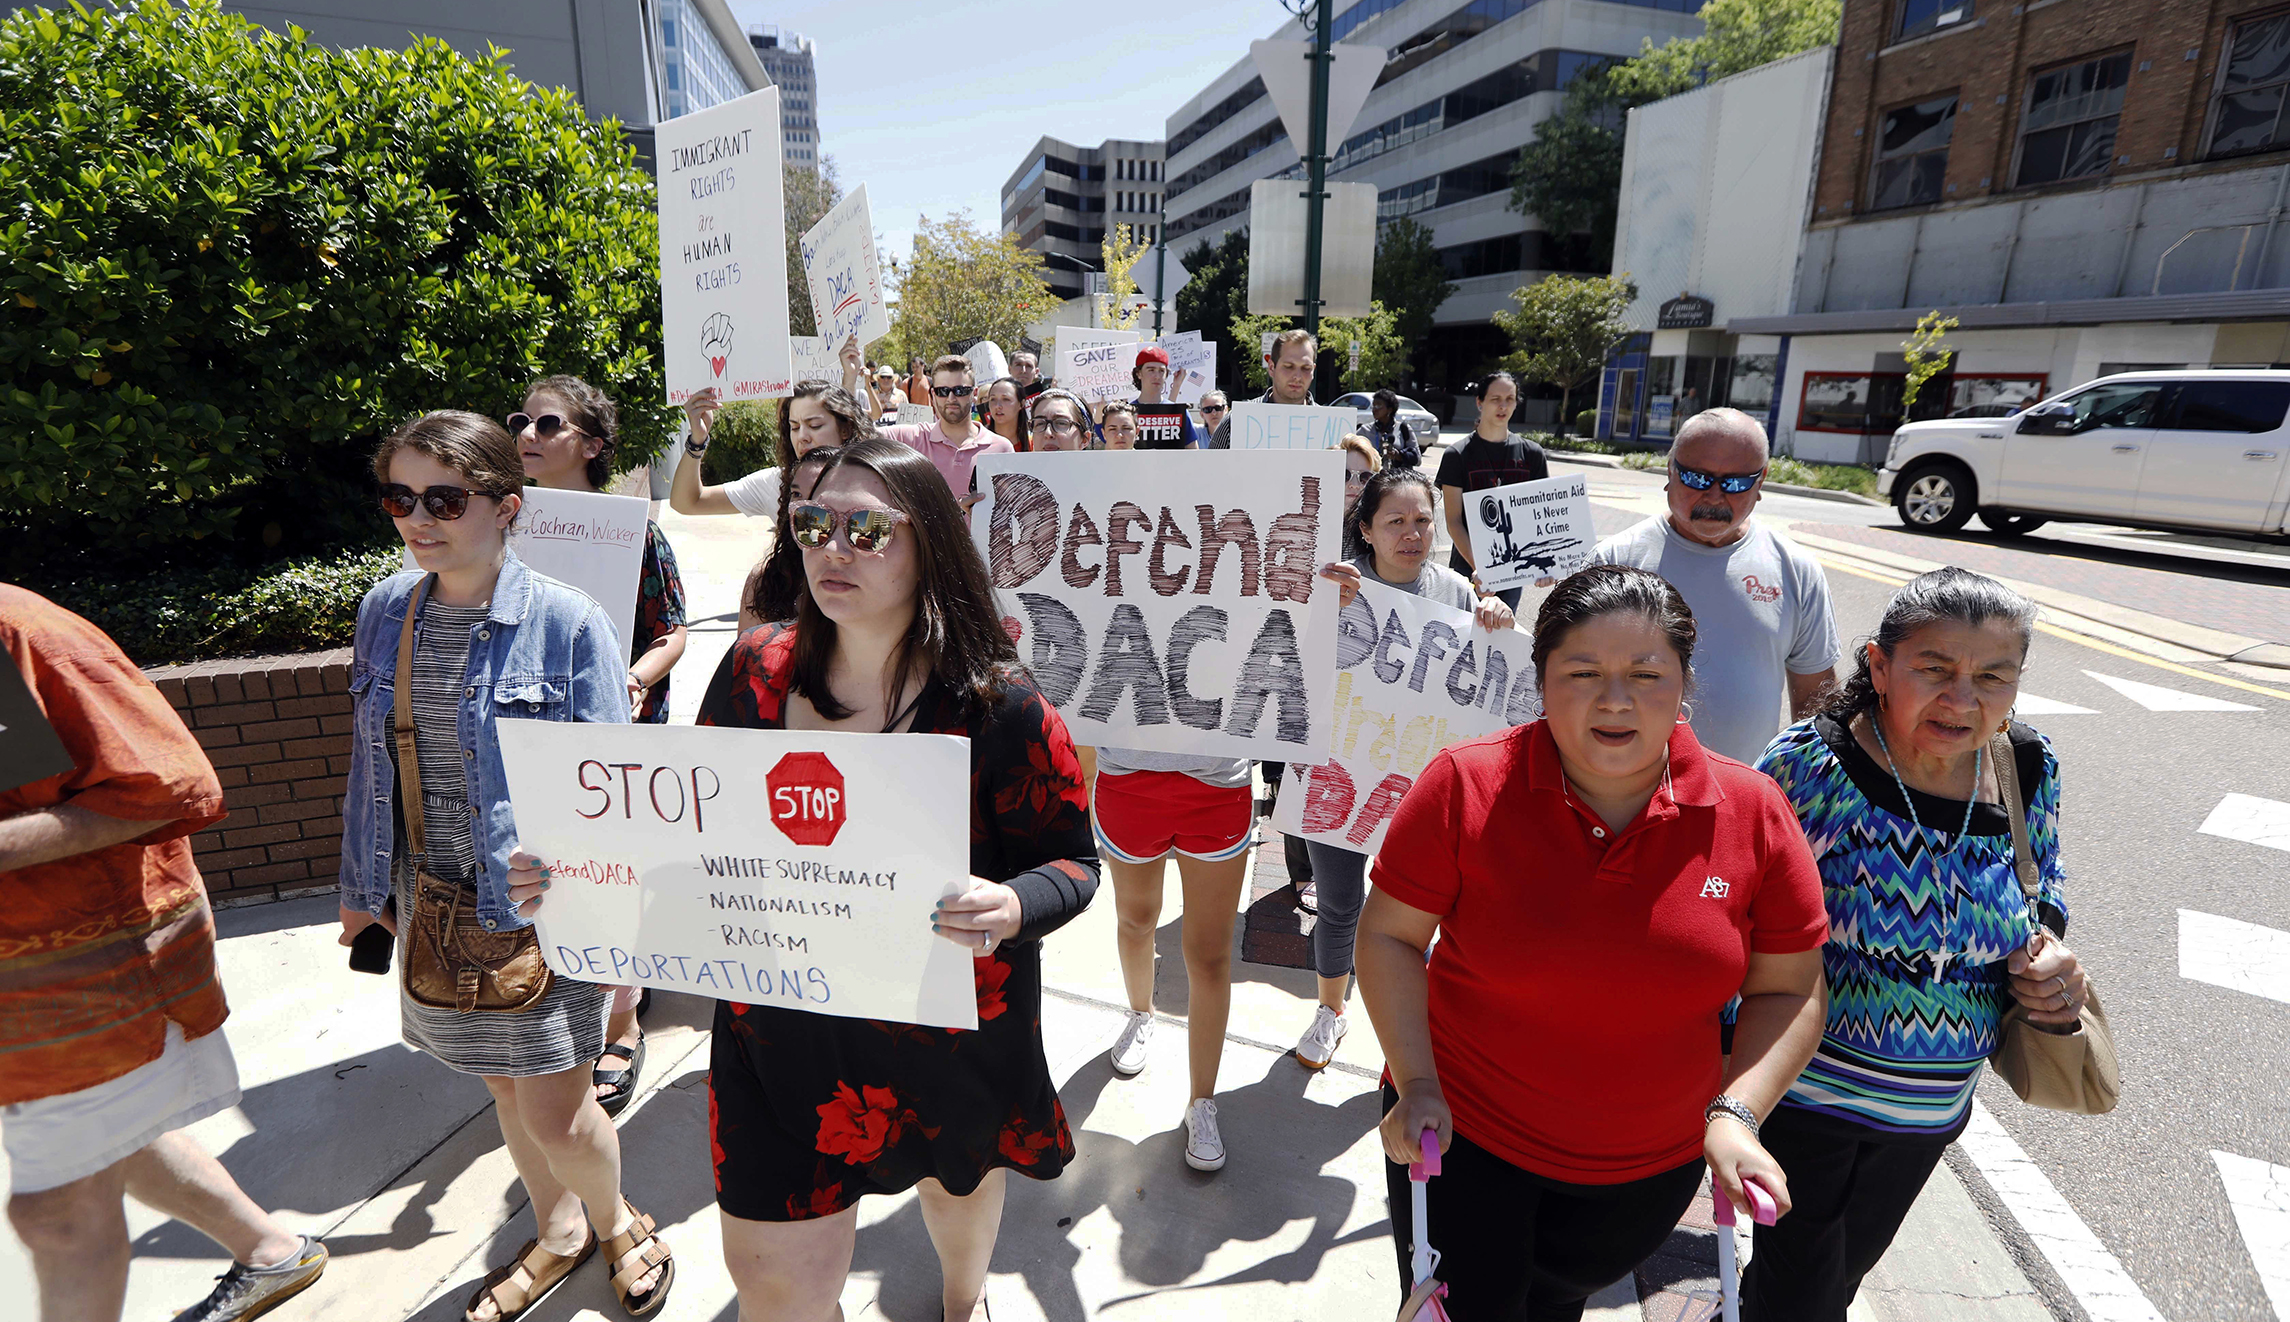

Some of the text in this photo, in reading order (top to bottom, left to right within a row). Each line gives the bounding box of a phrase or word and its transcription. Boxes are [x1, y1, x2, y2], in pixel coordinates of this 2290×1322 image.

[671, 129, 752, 173] IMMIGRANT
[690, 166, 736, 200] RIGHTS
[697, 214, 715, 232] are
[683, 232, 732, 264] HUMAN
[695, 262, 742, 293] RIGHTS
[827, 266, 856, 310] DACA
[790, 339, 814, 356] WE
[1161, 337, 1194, 349] America
[1073, 347, 1116, 367] SAVE
[1091, 363, 1118, 374] OUR
[1077, 371, 1133, 387] DREAMER
[1091, 384, 1120, 397] NEED
[1135, 425, 1181, 441] TTER
[1138, 416, 1181, 426] DESERVE
[1509, 483, 1585, 508] Humanitarian Aid
[531, 508, 641, 543] Cochran, Wicker
[1533, 506, 1569, 520] Is Never
[988, 472, 1322, 604] Defend
[1536, 522, 1570, 537] A Crime
[1741, 574, 1783, 600] Prep
[1015, 592, 1310, 746] DACA
[574, 758, 721, 834] STOP
[774, 785, 840, 822] STOP
[545, 859, 640, 886] efendDACA
[778, 858, 898, 893] SUPREMACY
[556, 944, 832, 1004] DEPORTATIONS
